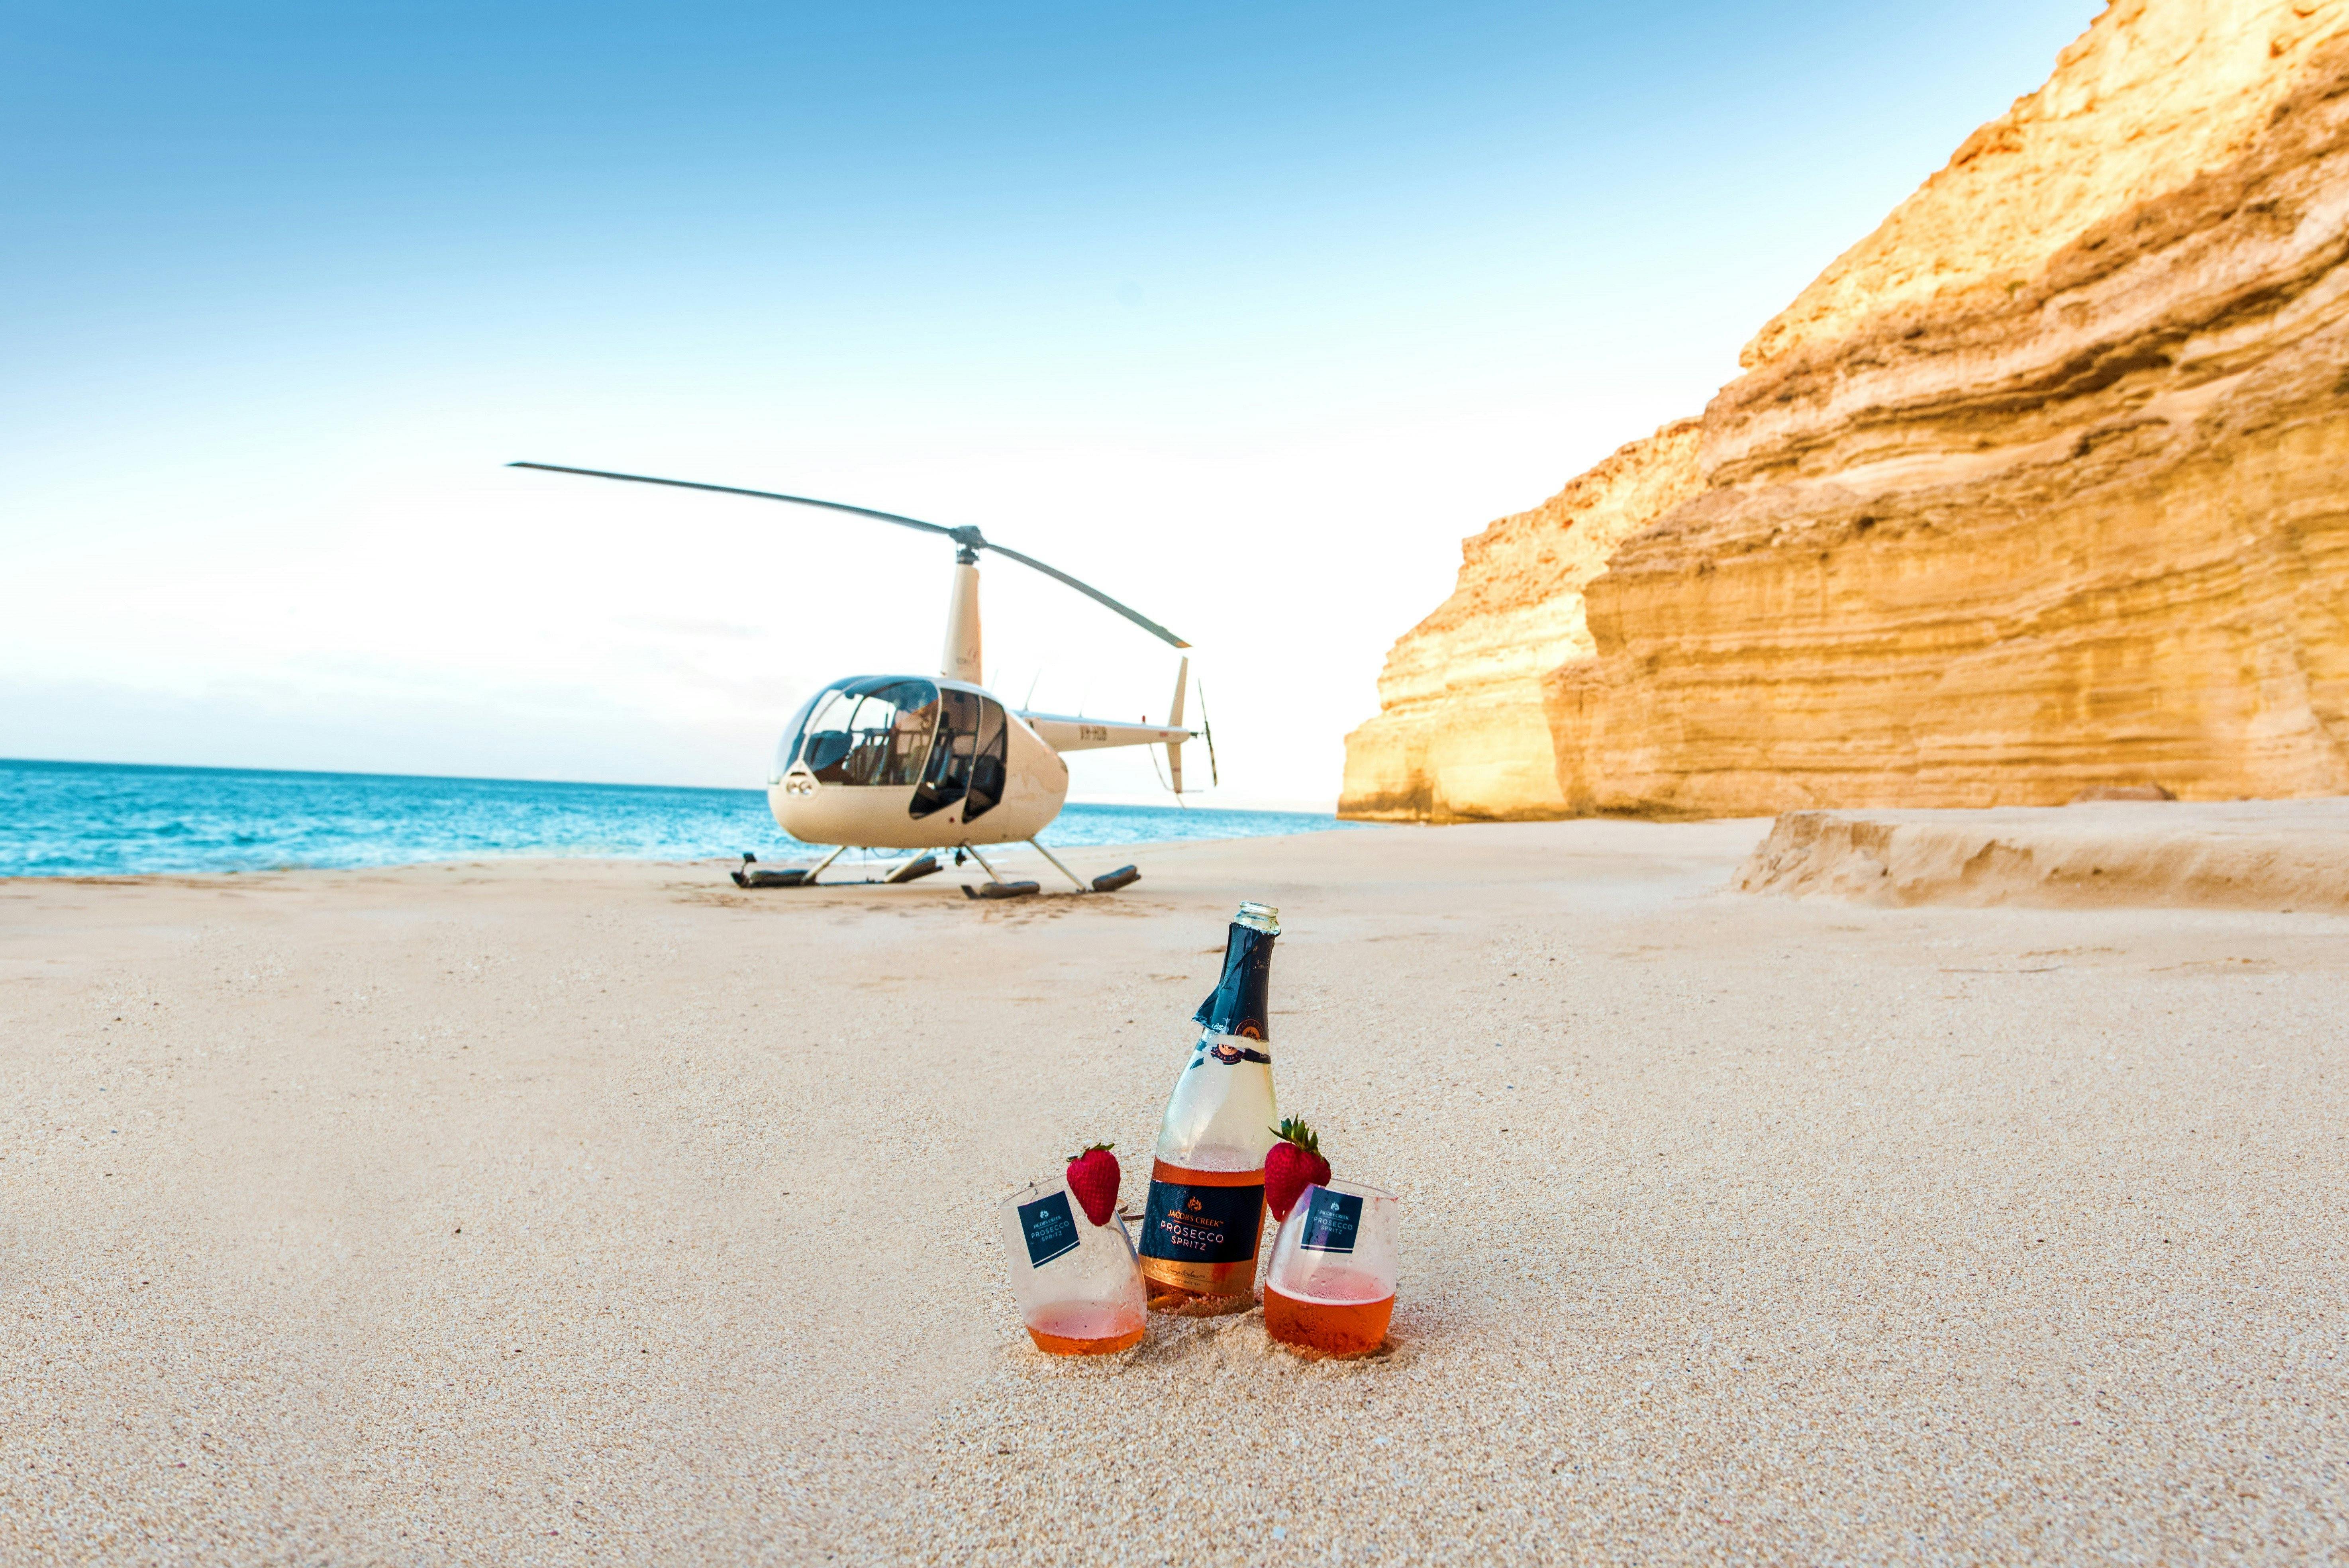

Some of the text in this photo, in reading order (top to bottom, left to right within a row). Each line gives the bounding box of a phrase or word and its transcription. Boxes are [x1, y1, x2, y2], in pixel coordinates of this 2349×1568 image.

[1167, 1209, 1194, 1222] JACOB'S
[1031, 1221, 1069, 1239] PROSECCO
[1314, 1216, 1353, 1230] PROSECCO
[1321, 1225, 1343, 1235] SPRITZ
[1041, 1231, 1062, 1242] SPRITZ
[1160, 1220, 1224, 1243] PROSECCO
[1171, 1235, 1207, 1251] SPRITZ
